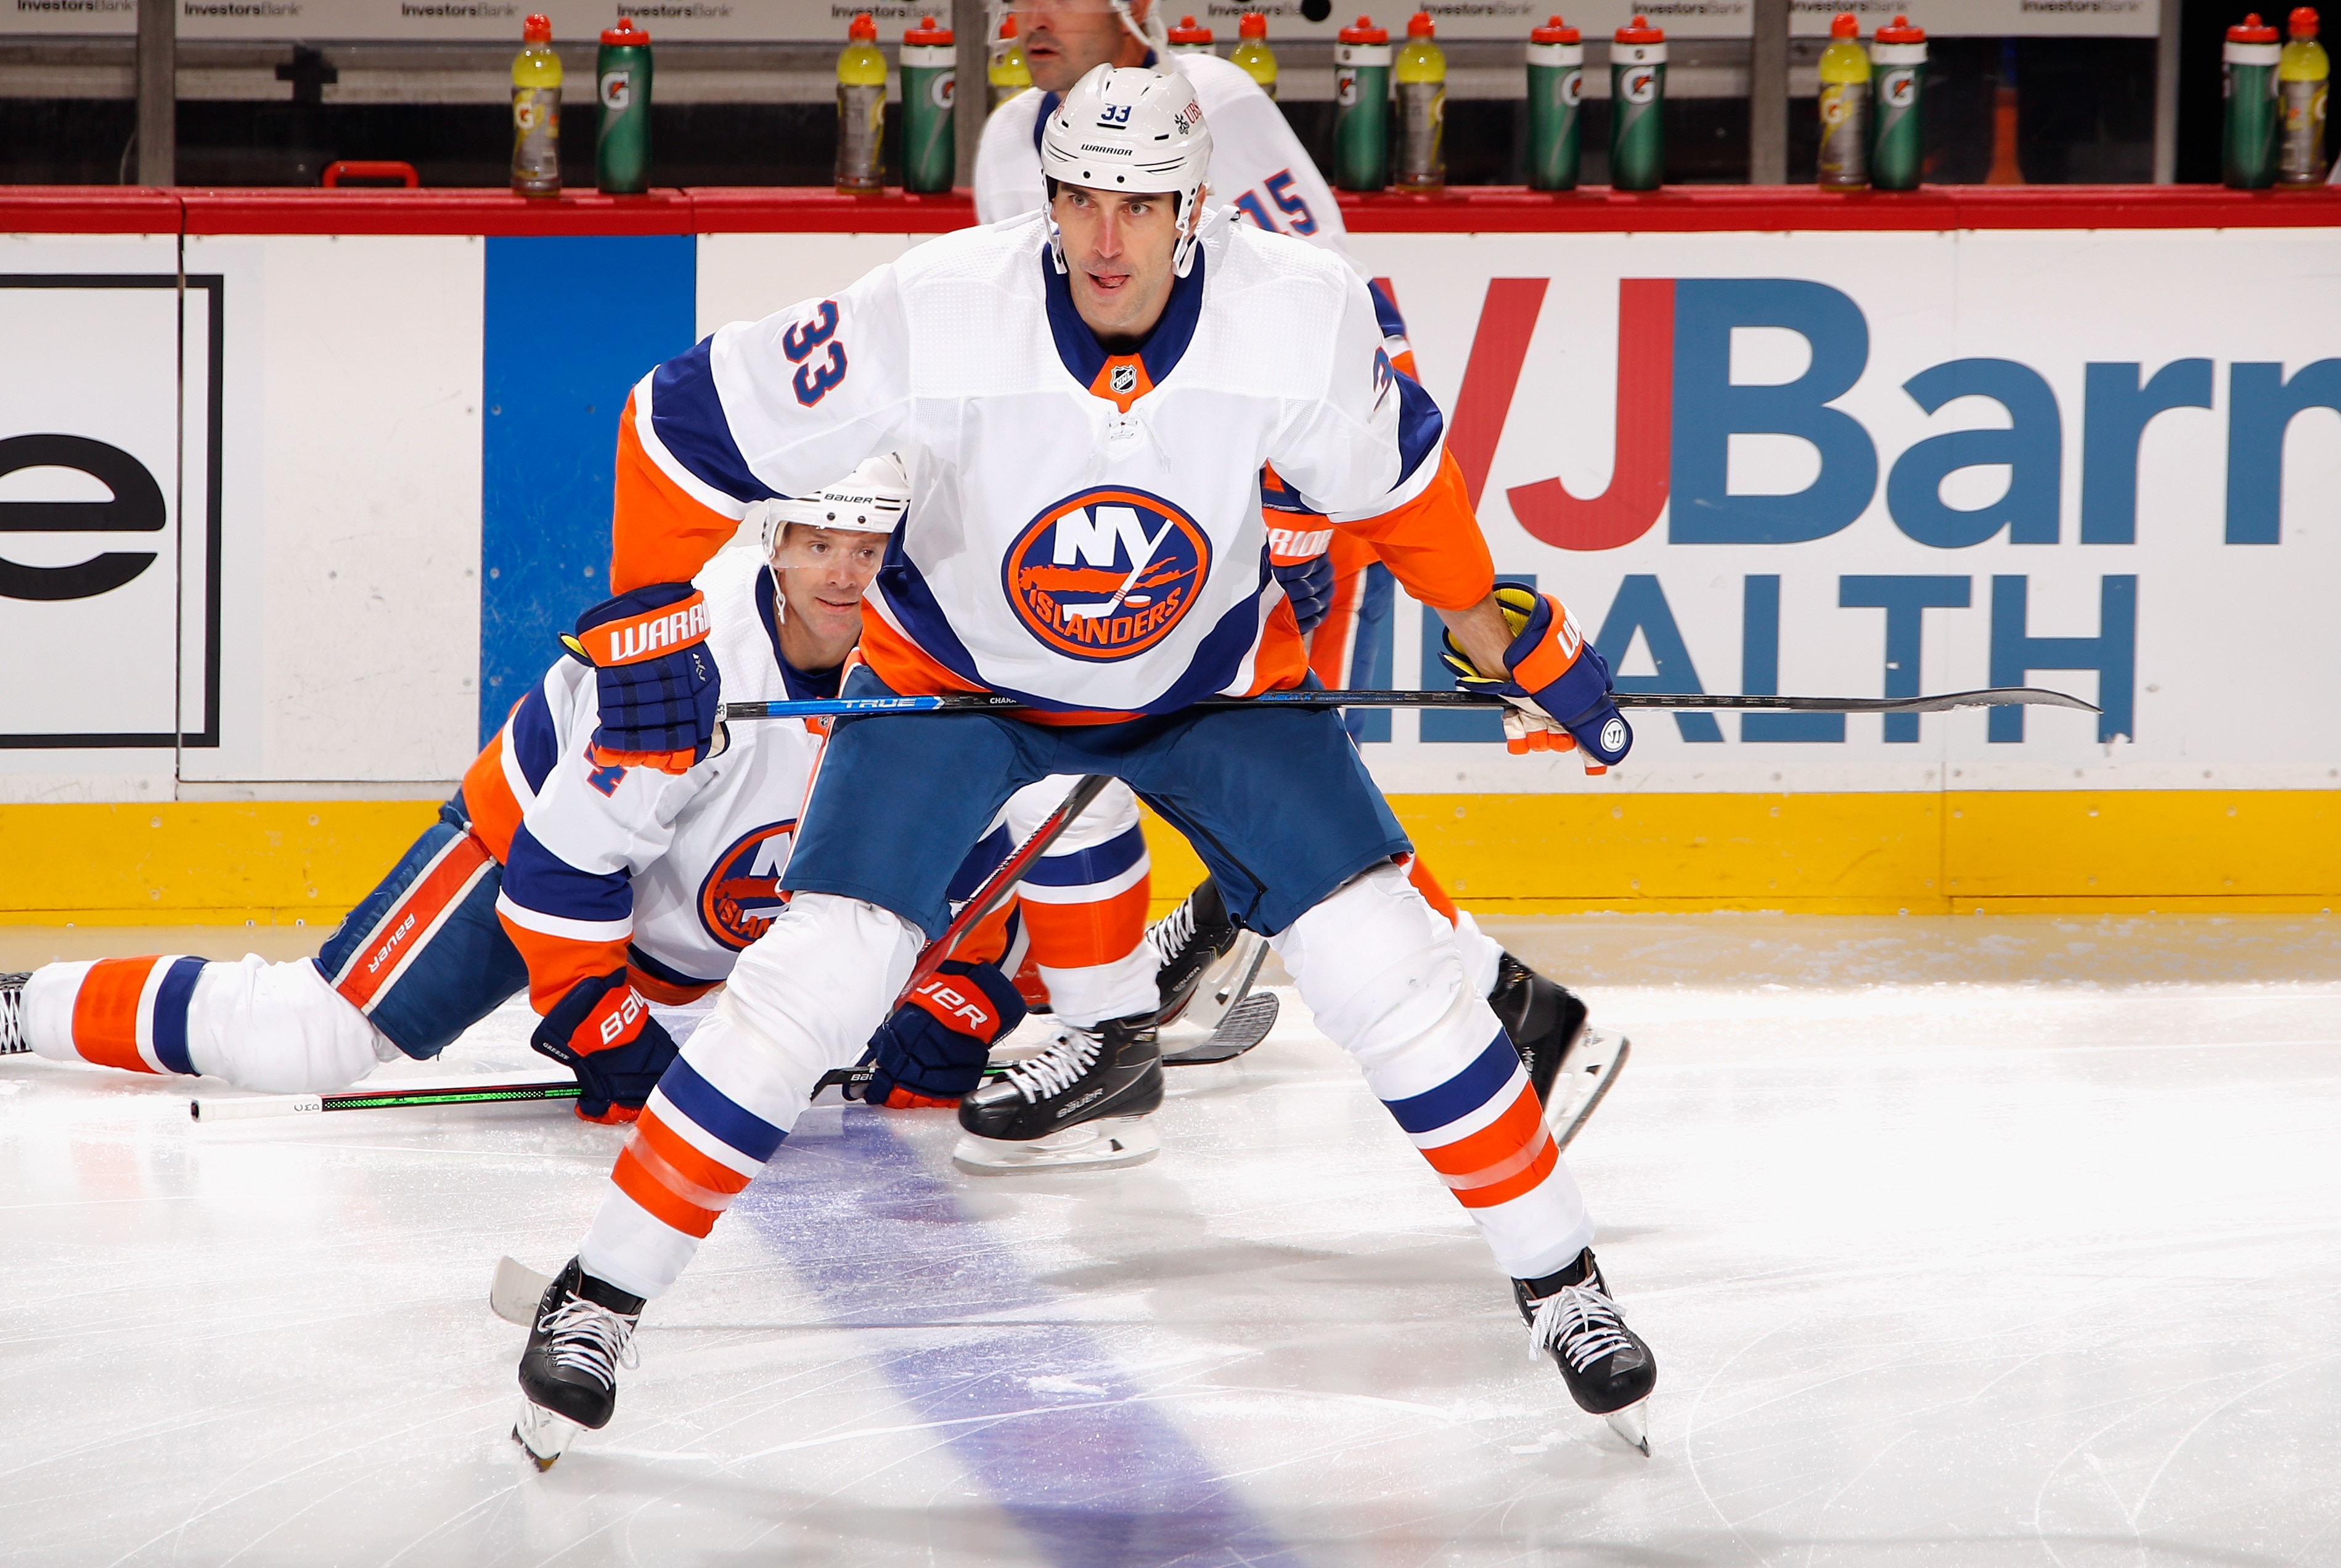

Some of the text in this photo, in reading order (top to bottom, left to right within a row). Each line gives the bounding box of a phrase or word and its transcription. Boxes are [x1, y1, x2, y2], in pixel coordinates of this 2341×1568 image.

[185, 2, 303, 16] InvestorsBank
[401, 2, 517, 17] InvestorsBank
[617, 3, 733, 17] InvestorsBank
[832, 3, 947, 17] InvestorsBank
[1207, 4, 1303, 17] InvestorsBa
[1419, 2, 1536, 16] InvestorsBank
[1632, 2, 1747, 15] InvestorsBank
[600, 71, 629, 110] G
[1621, 65, 1656, 105] G
[1882, 68, 1915, 108] G
[1100, 104, 1132, 123] 33
[1183, 99, 1203, 124] UBS
[1080, 143, 1134, 157] WARRIOR
[1233, 167, 1320, 238] 15
[782, 299, 848, 408] 33
[1265, 526, 1334, 557] RIOR
[1028, 587, 1182, 645] ISLANDERS
[841, 697, 917, 709] TRUE
[542, 1042, 570, 1061] GREENE
